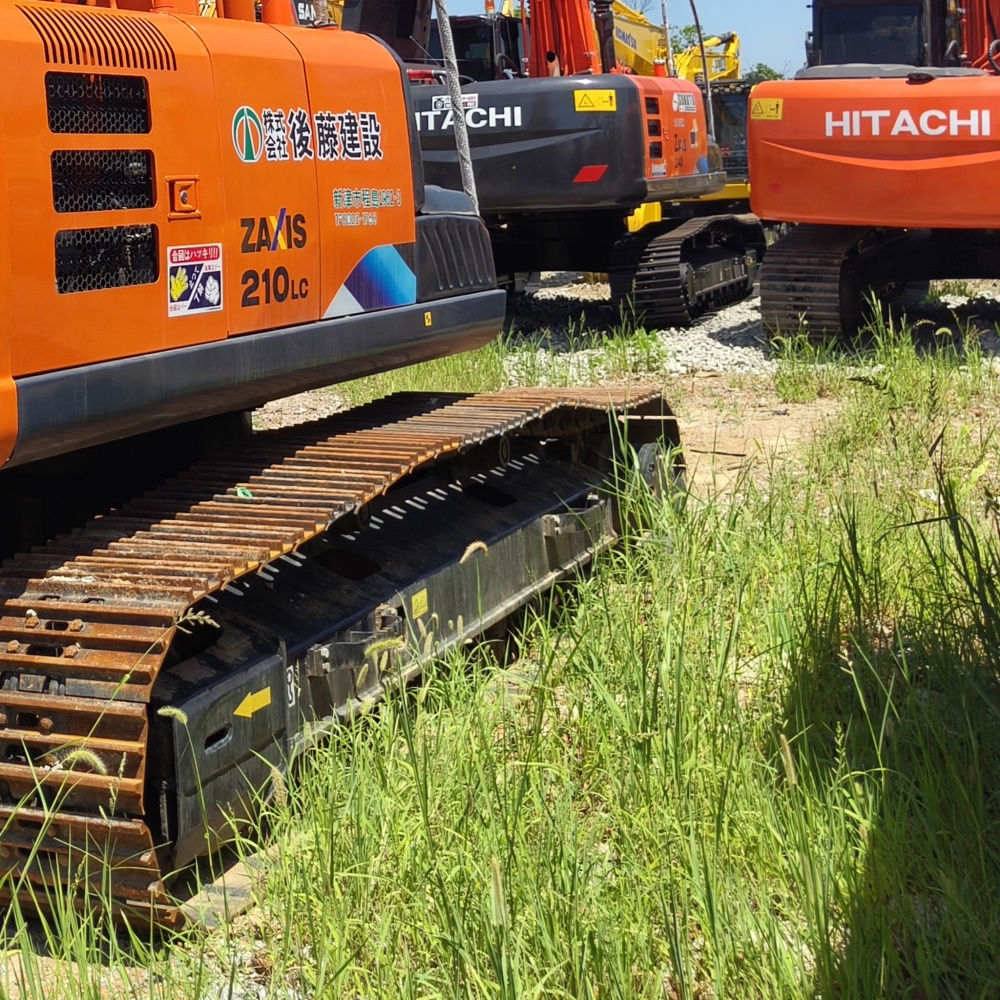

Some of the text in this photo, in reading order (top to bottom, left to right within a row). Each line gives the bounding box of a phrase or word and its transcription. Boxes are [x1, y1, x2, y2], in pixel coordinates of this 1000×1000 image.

[288, 110, 382, 160] 後藤建設
[825, 109, 991, 137] HITACHI
[240, 207, 307, 253] ZAXIS
